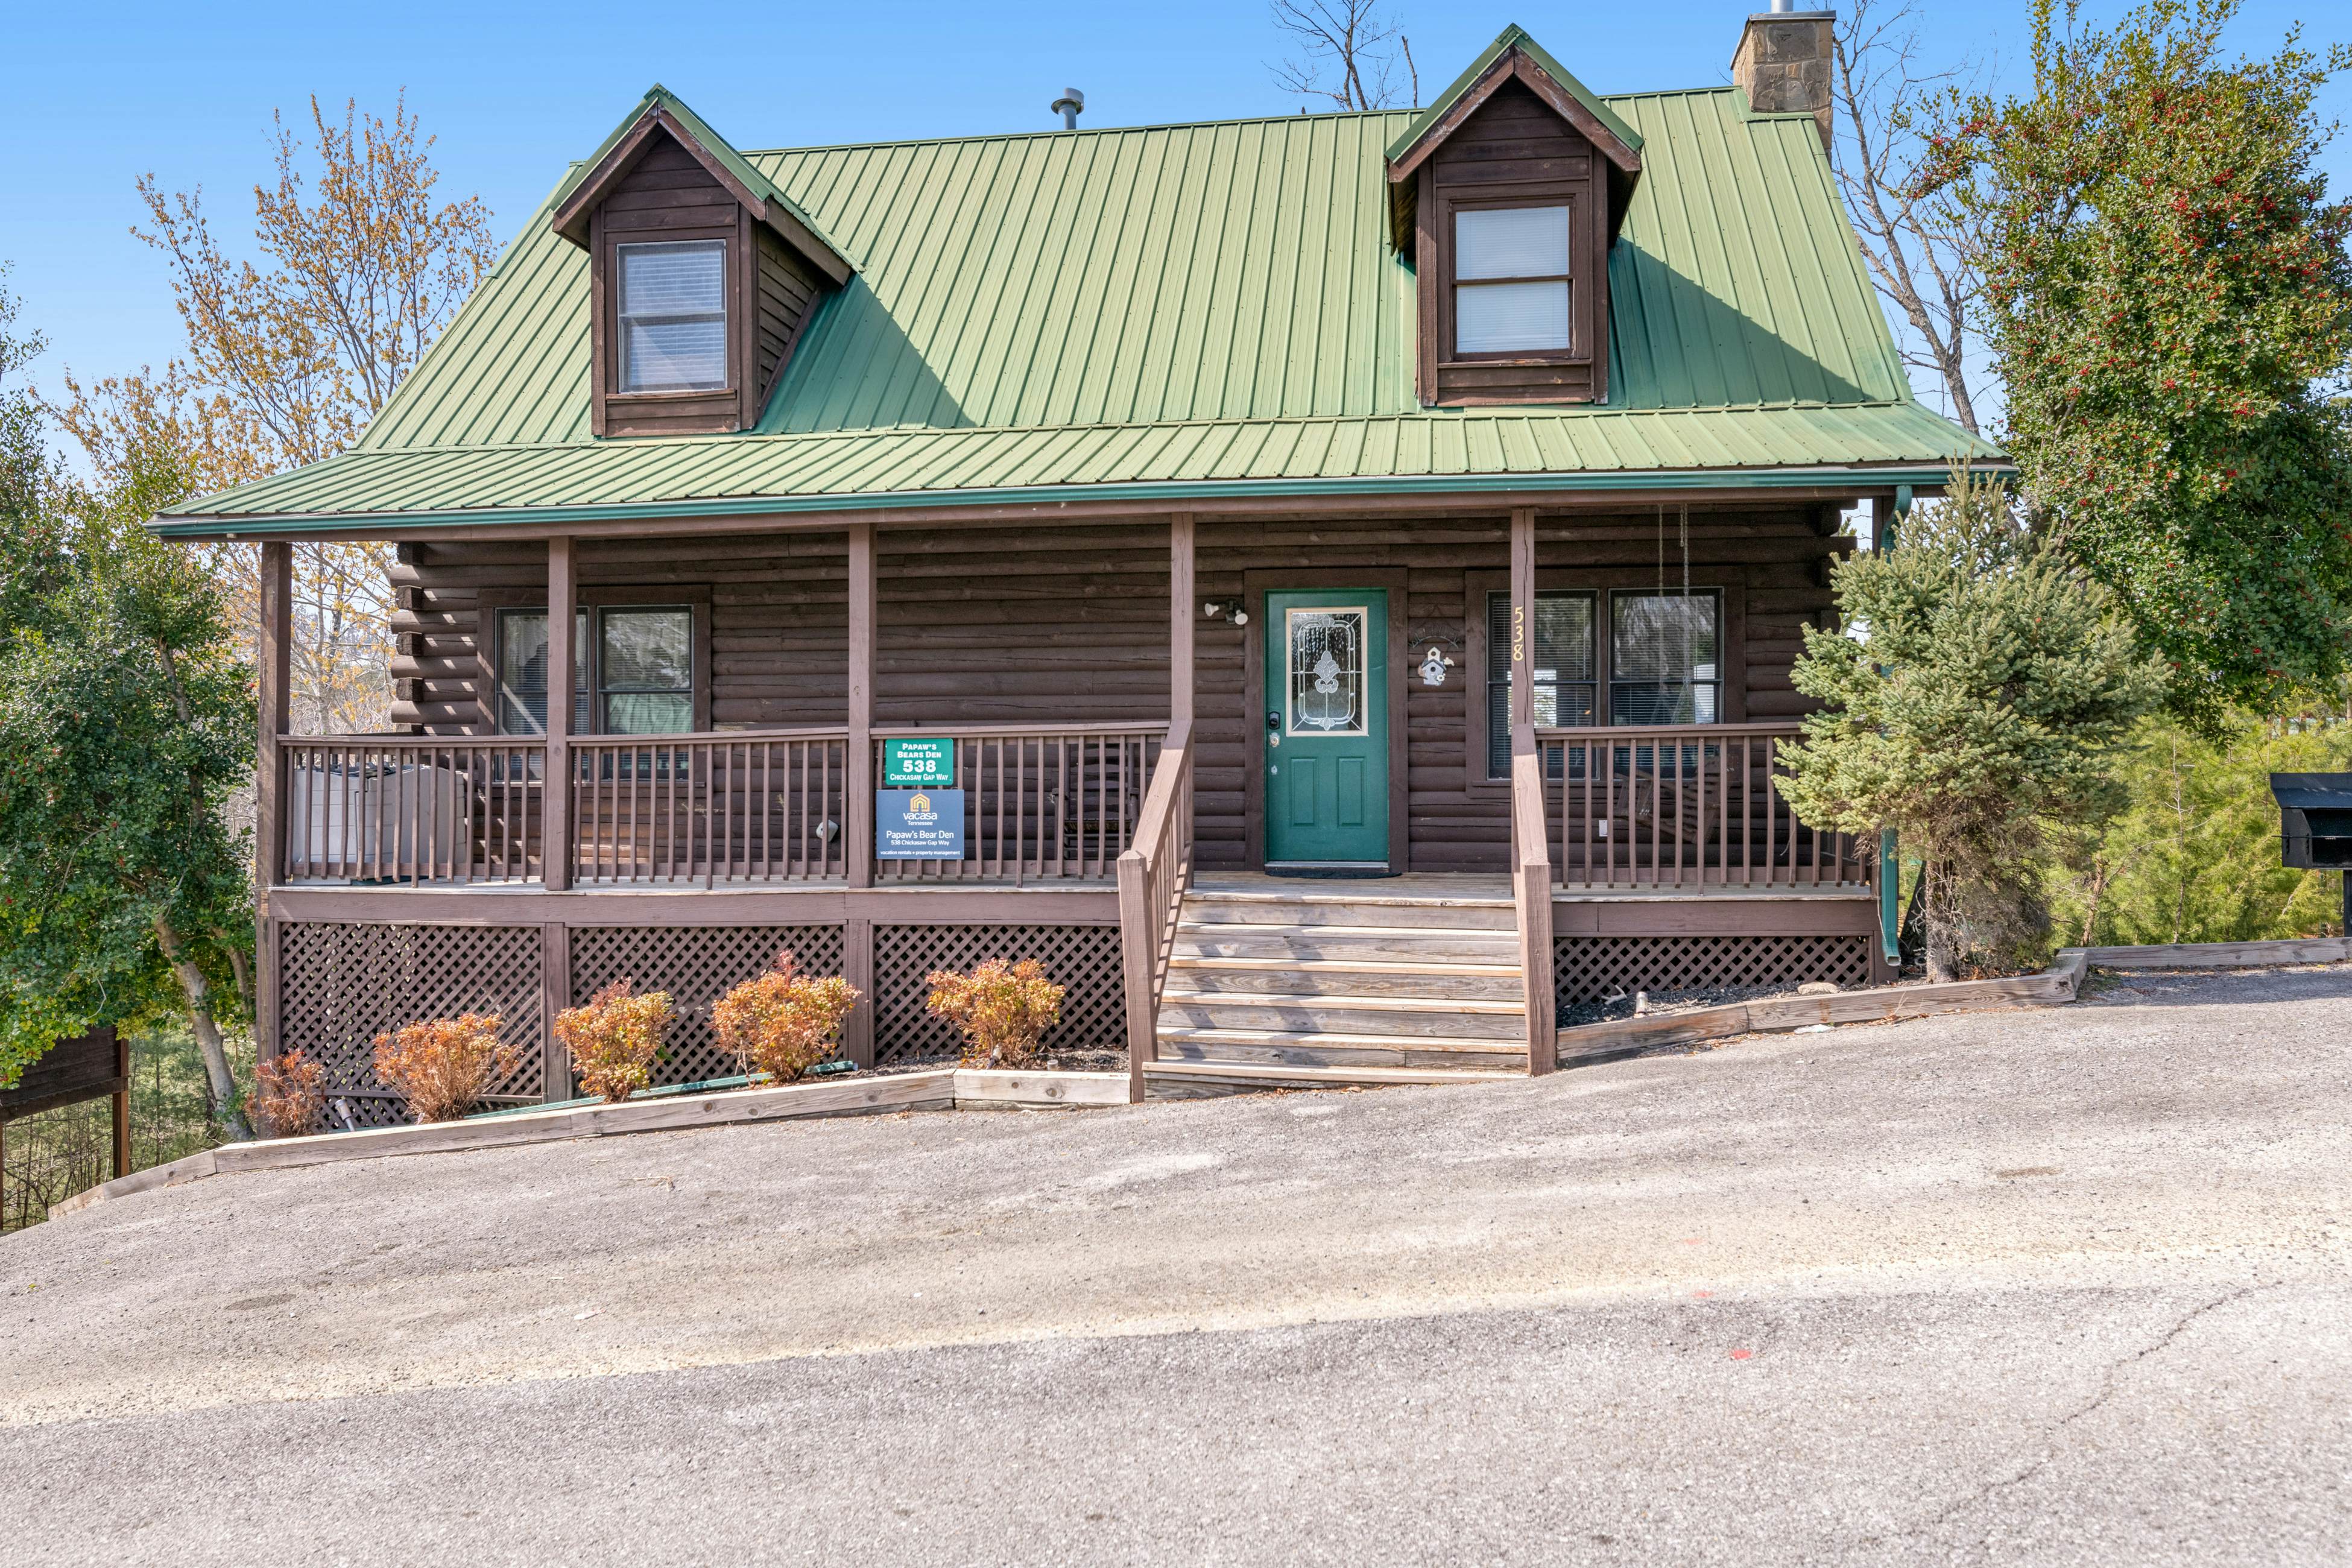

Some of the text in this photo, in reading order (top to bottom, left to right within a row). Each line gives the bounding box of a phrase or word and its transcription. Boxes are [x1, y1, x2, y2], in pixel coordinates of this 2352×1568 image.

[1513, 606, 1523, 661] 538
[903, 760, 936, 773] 538
[887, 830, 918, 839] Papaw's
